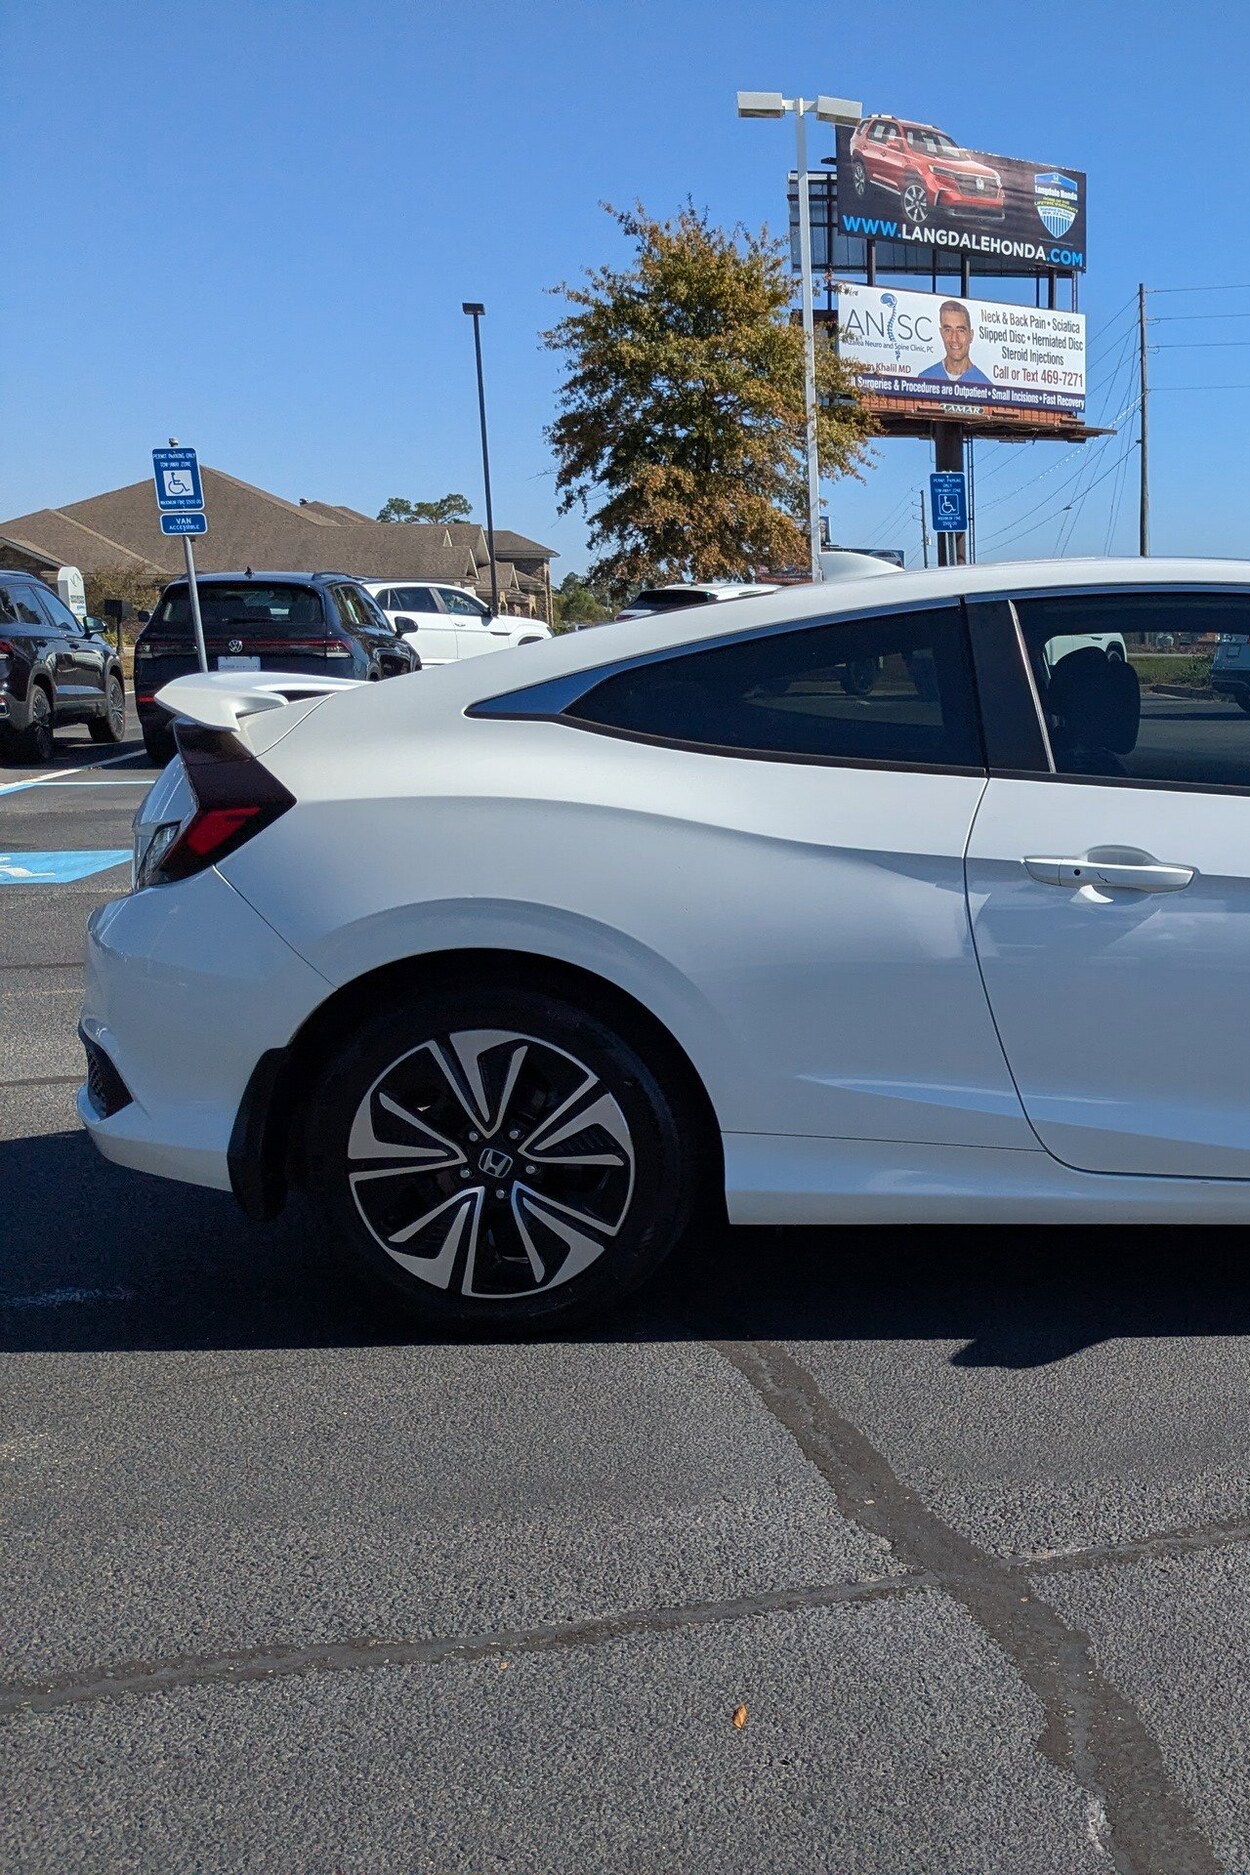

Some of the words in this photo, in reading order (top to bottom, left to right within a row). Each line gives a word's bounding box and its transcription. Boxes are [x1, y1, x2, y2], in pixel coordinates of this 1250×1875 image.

[842, 214, 1083, 267] WWW.LANGDALEHONDA.COM
[981, 309, 1001, 323] Neck
[1002, 312, 1008, 325] &
[1010, 313, 1028, 327] Back
[1030, 315, 1046, 329] Pain
[1052, 318, 1080, 334] Sciatica
[979, 326, 1007, 343] Slipped
[1009, 330, 1025, 344] Disc
[1032, 333, 1066, 349] Herniated
[1068, 337, 1083, 351] Disc
[876, 362, 897, 373] Khalil
[899, 364, 911, 374] MD
[1001, 346, 1028, 361] Steroid
[1030, 349, 1064, 366] Injections
[993, 365, 1009, 379] Call
[1011, 369, 1020, 380] or
[1022, 368, 1038, 382] Text
[1041, 369, 1083, 387] 469-7271
[893, 379, 900, 391] &
[901, 380, 940, 394] Procedures
[941, 385, 953, 395] are
[954, 384, 988, 399] Outpatient
[991, 388, 1010, 401] Small
[1011, 390, 1039, 404] Incisions
[1043, 393, 1056, 405] Fast
[1057, 396, 1085, 410] Recovery
